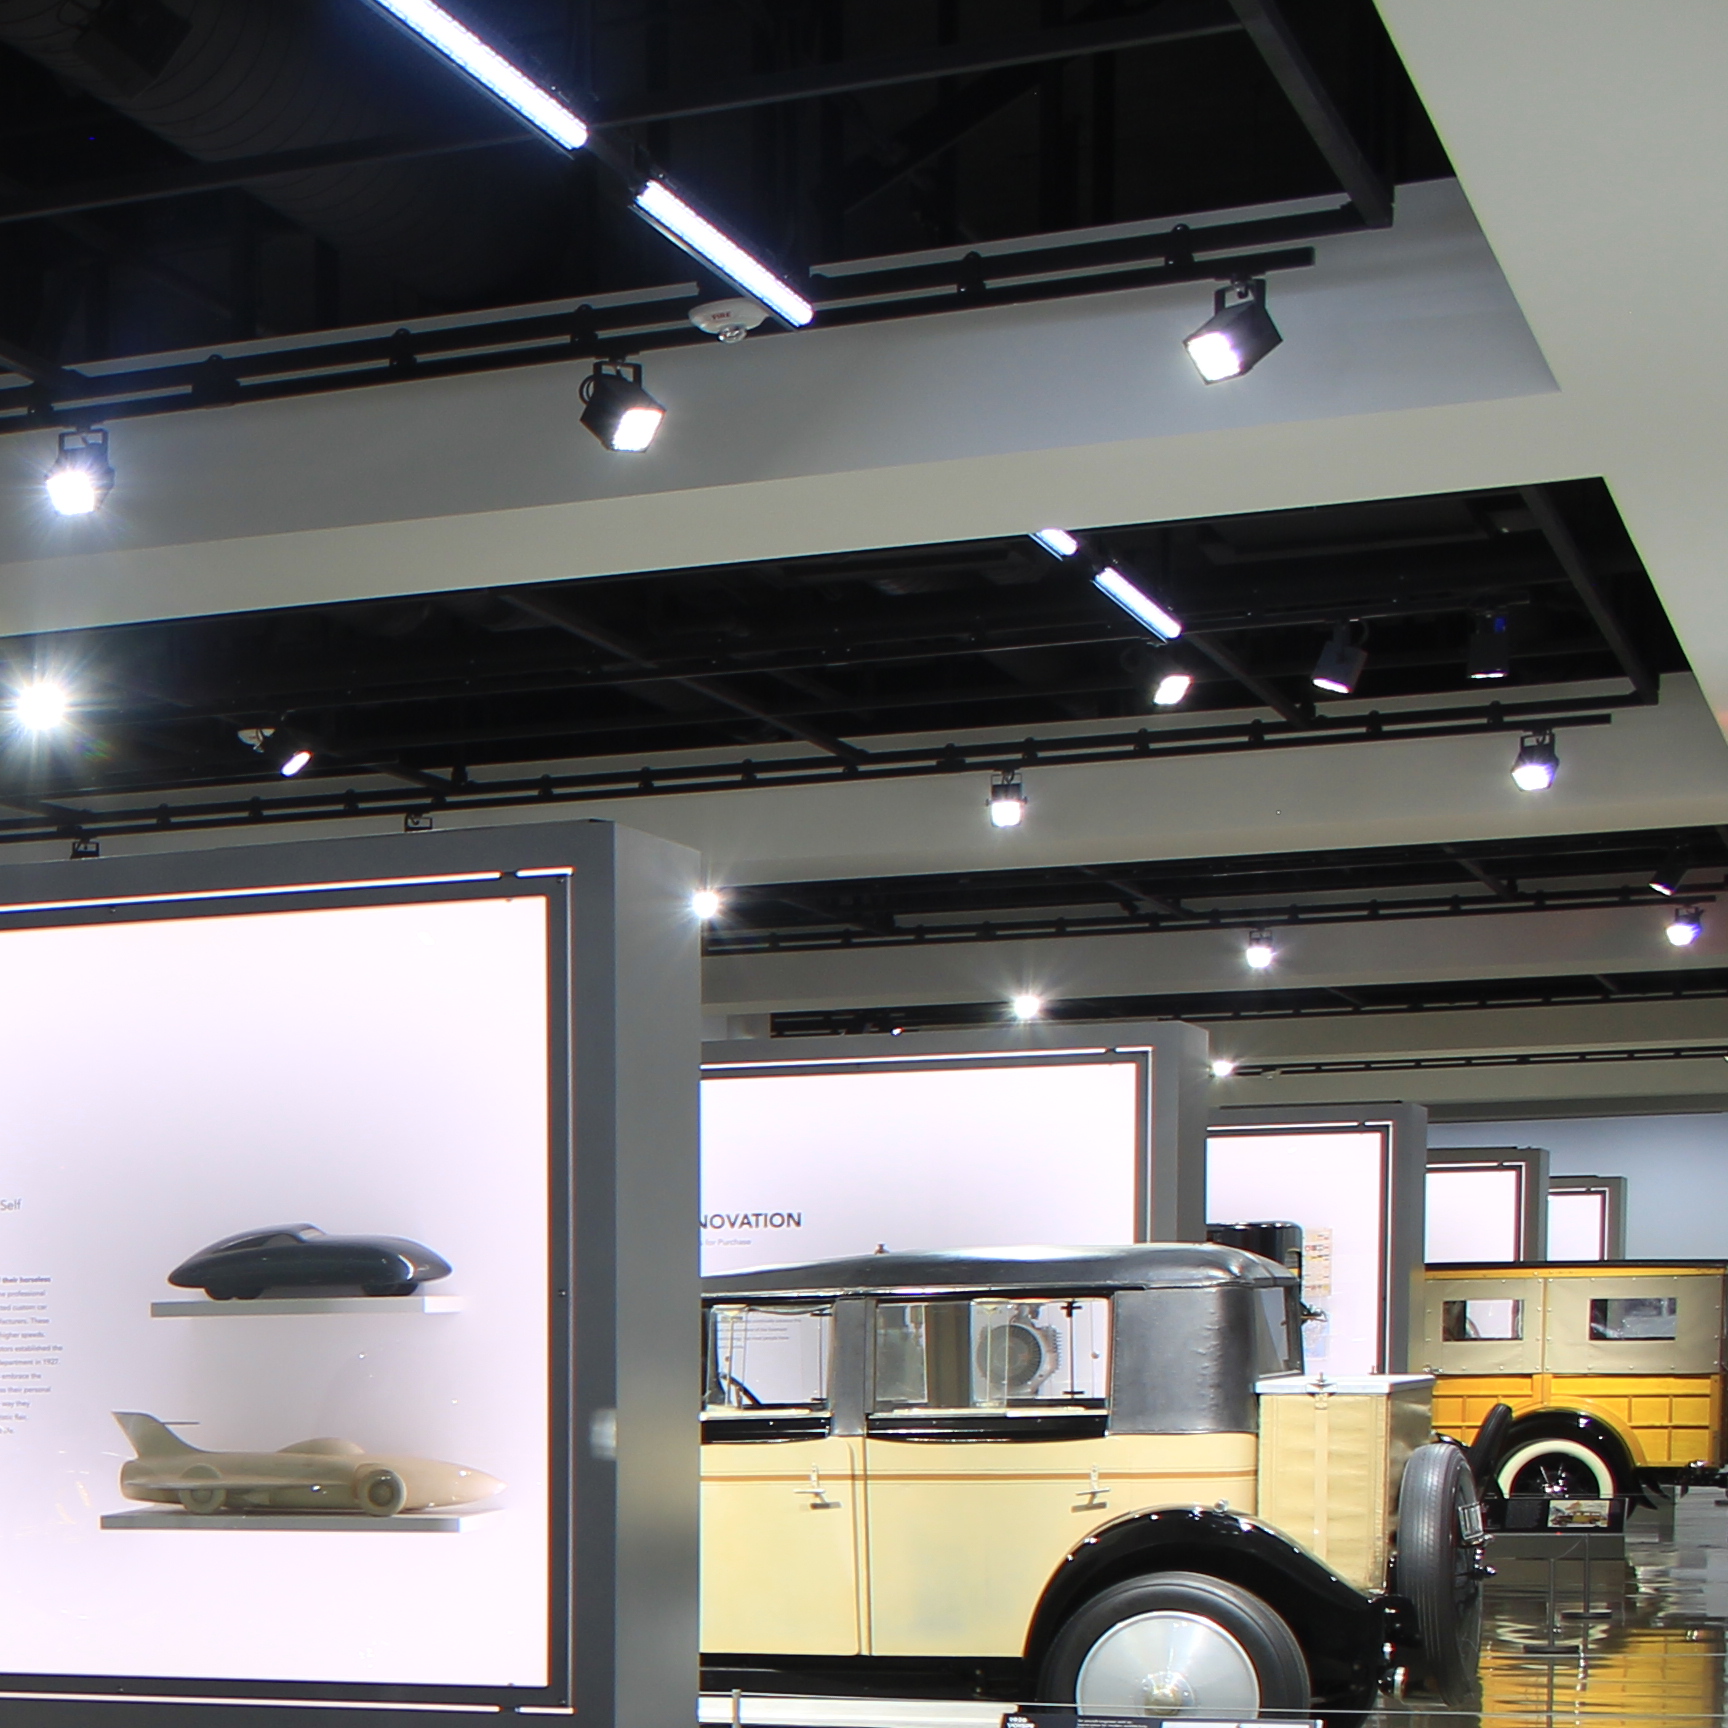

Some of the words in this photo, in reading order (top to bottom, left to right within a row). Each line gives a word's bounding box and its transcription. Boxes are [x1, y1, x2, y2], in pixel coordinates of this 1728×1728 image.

[0, 1198, 21, 1211] Self
[3, 1276, 17, 1285] their
[19, 1275, 51, 1284] horseless
